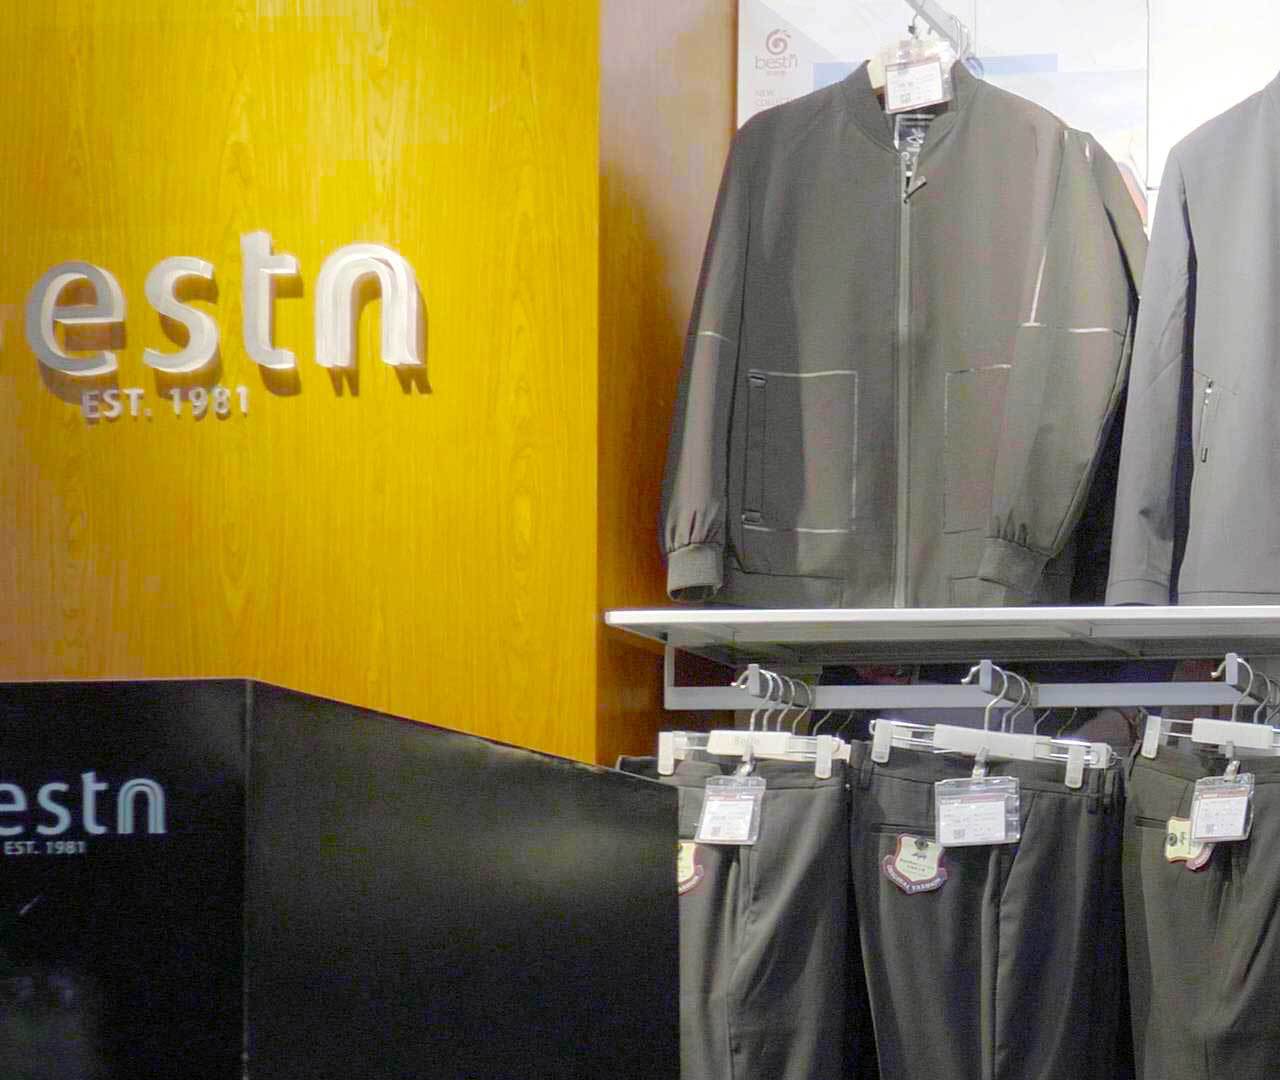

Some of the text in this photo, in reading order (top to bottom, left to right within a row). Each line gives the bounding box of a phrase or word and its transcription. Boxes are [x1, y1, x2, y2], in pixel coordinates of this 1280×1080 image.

[25, 230, 425, 377] estn
[80, 385, 250, 421] EST. 1981
[4, 841, 87, 855] EST. 1981
